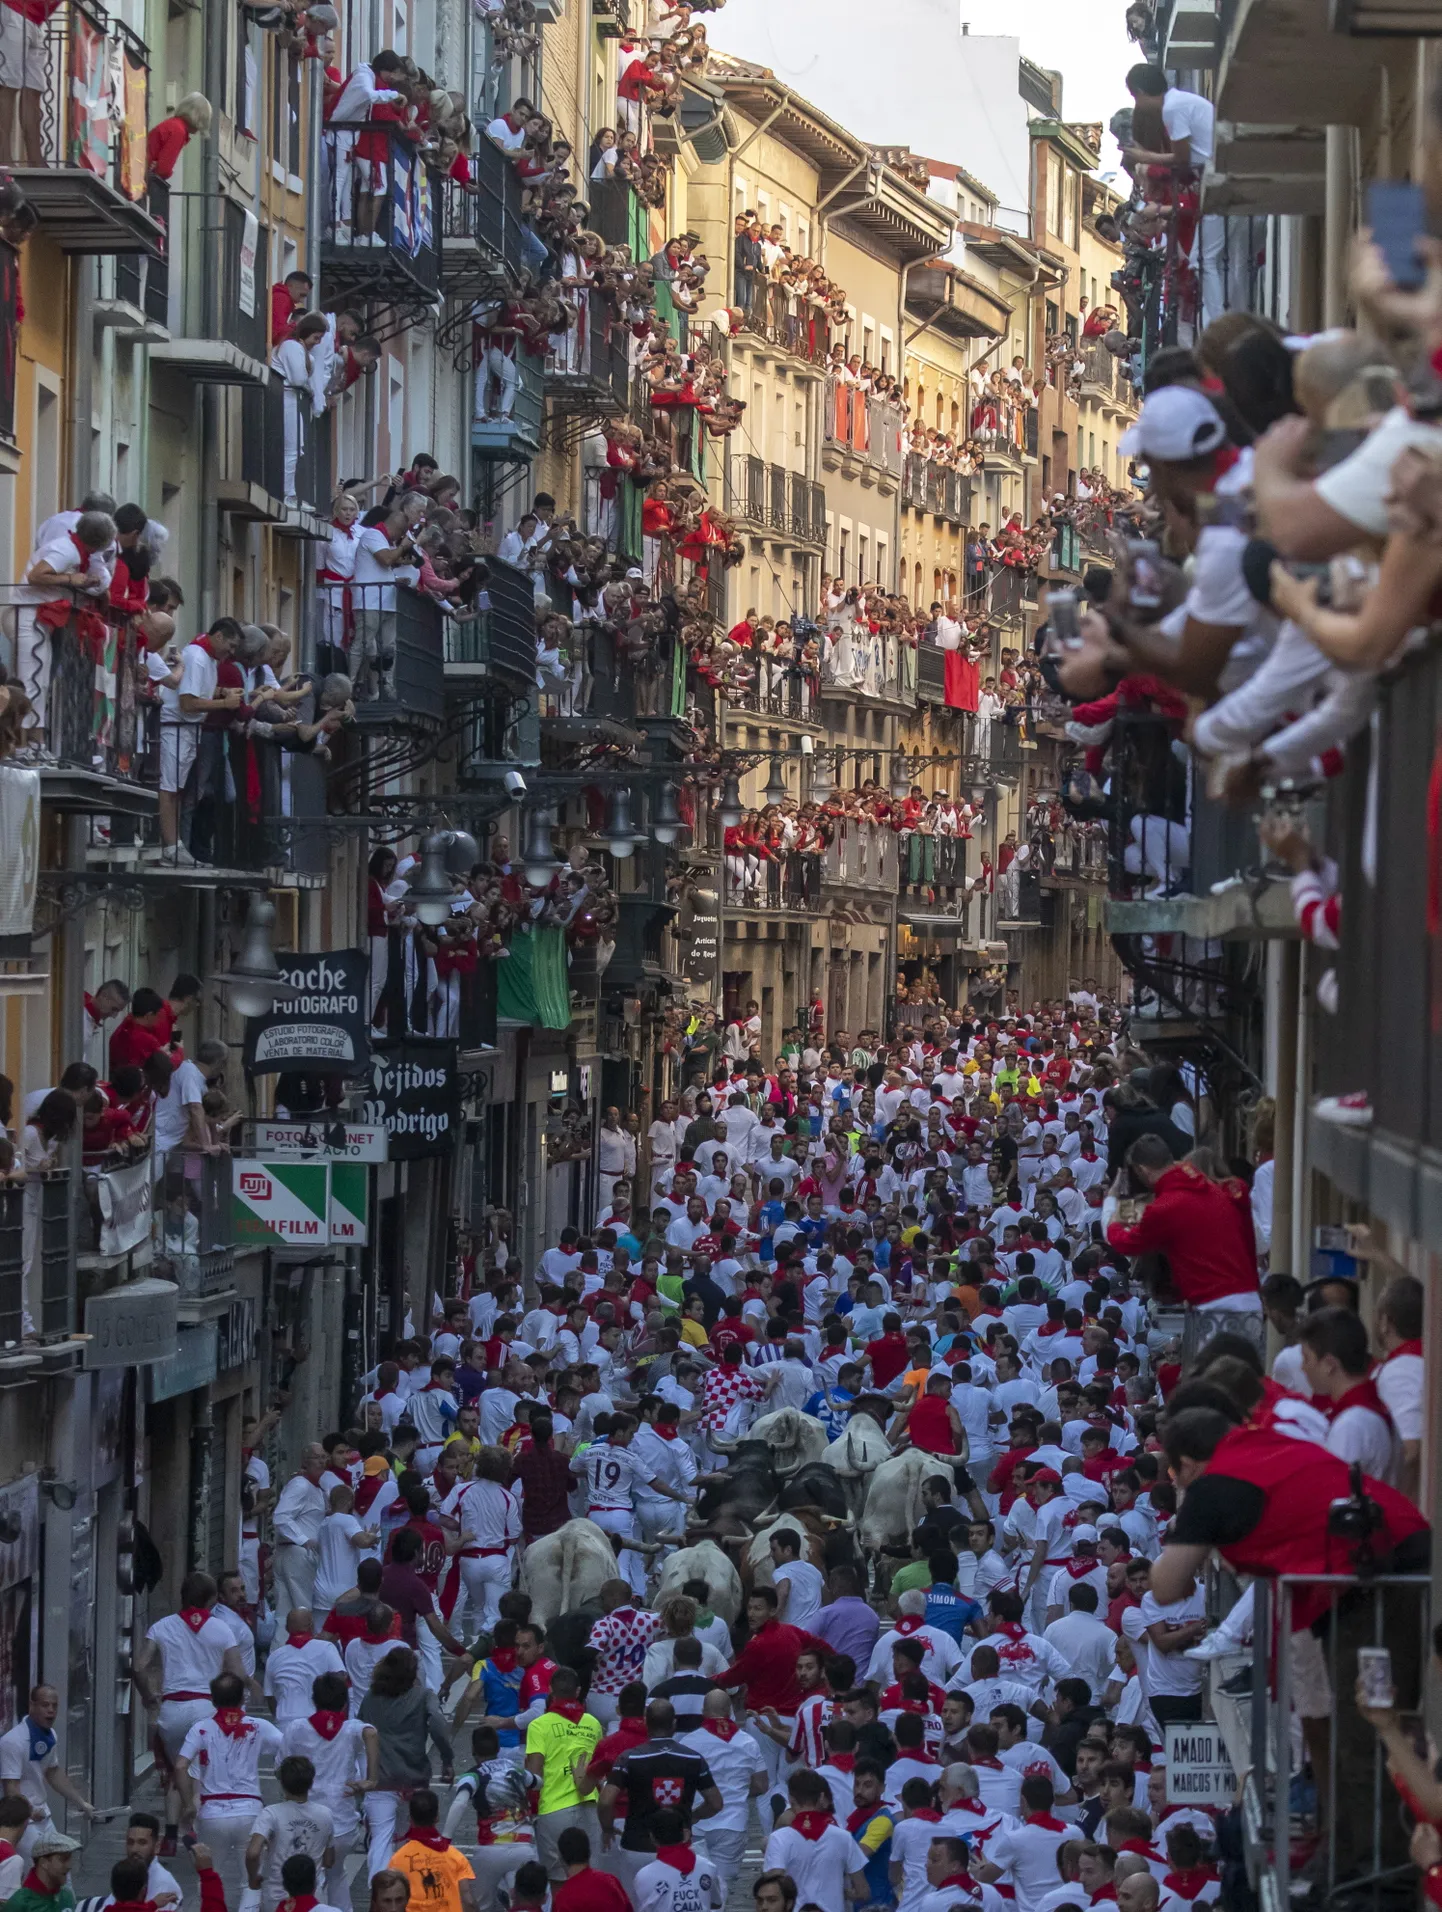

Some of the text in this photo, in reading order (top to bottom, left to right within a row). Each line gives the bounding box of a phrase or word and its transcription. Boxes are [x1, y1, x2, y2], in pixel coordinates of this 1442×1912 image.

[263, 1025, 295, 1040] ESTUDIO
[268, 1036, 345, 1048] LABORATORIO COLOR
[263, 1047, 346, 1058] VENTA DE MATERIAL
[369, 1054, 447, 1098] Tejidos
[362, 1099, 449, 1142] Rodrigo
[595, 1458, 621, 1490] 19
[928, 1594, 956, 1605] SIMON
[1173, 1737, 1231, 1763] AMADO M
[1173, 1772, 1210, 1792] MARCOS
[1214, 1772, 1220, 1792] Y
[673, 1888, 700, 1902] FUCK
